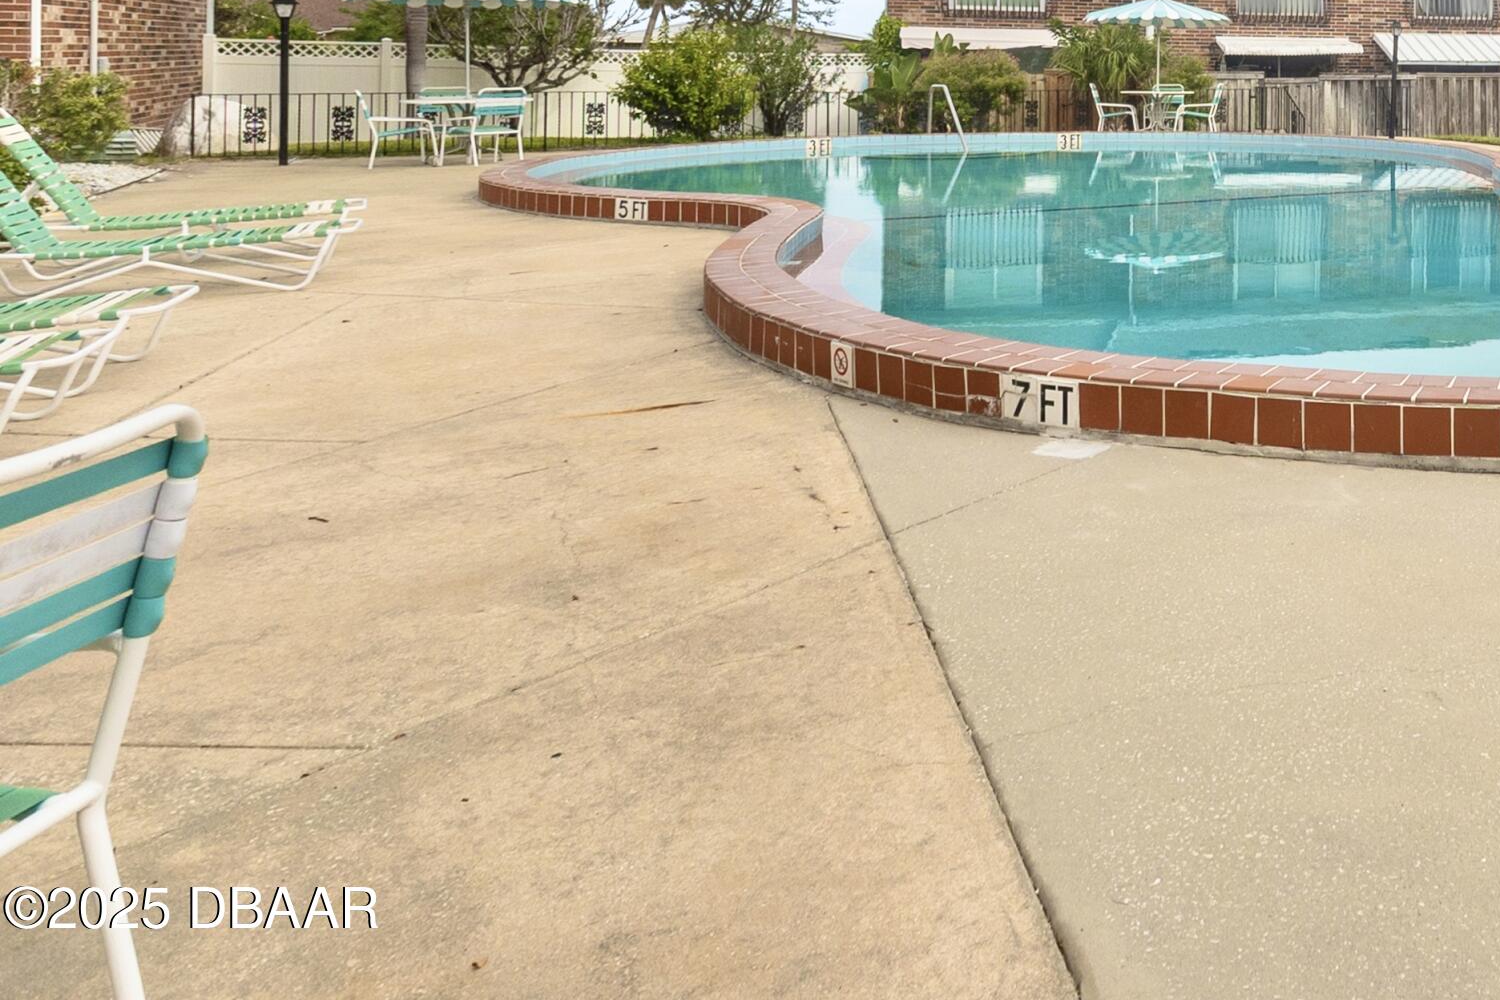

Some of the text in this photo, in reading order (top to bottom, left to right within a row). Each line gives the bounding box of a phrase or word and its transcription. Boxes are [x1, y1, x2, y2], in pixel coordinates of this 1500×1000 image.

[618, 200, 646, 220] 5 FT
[1012, 379, 1074, 425] 7 FT
